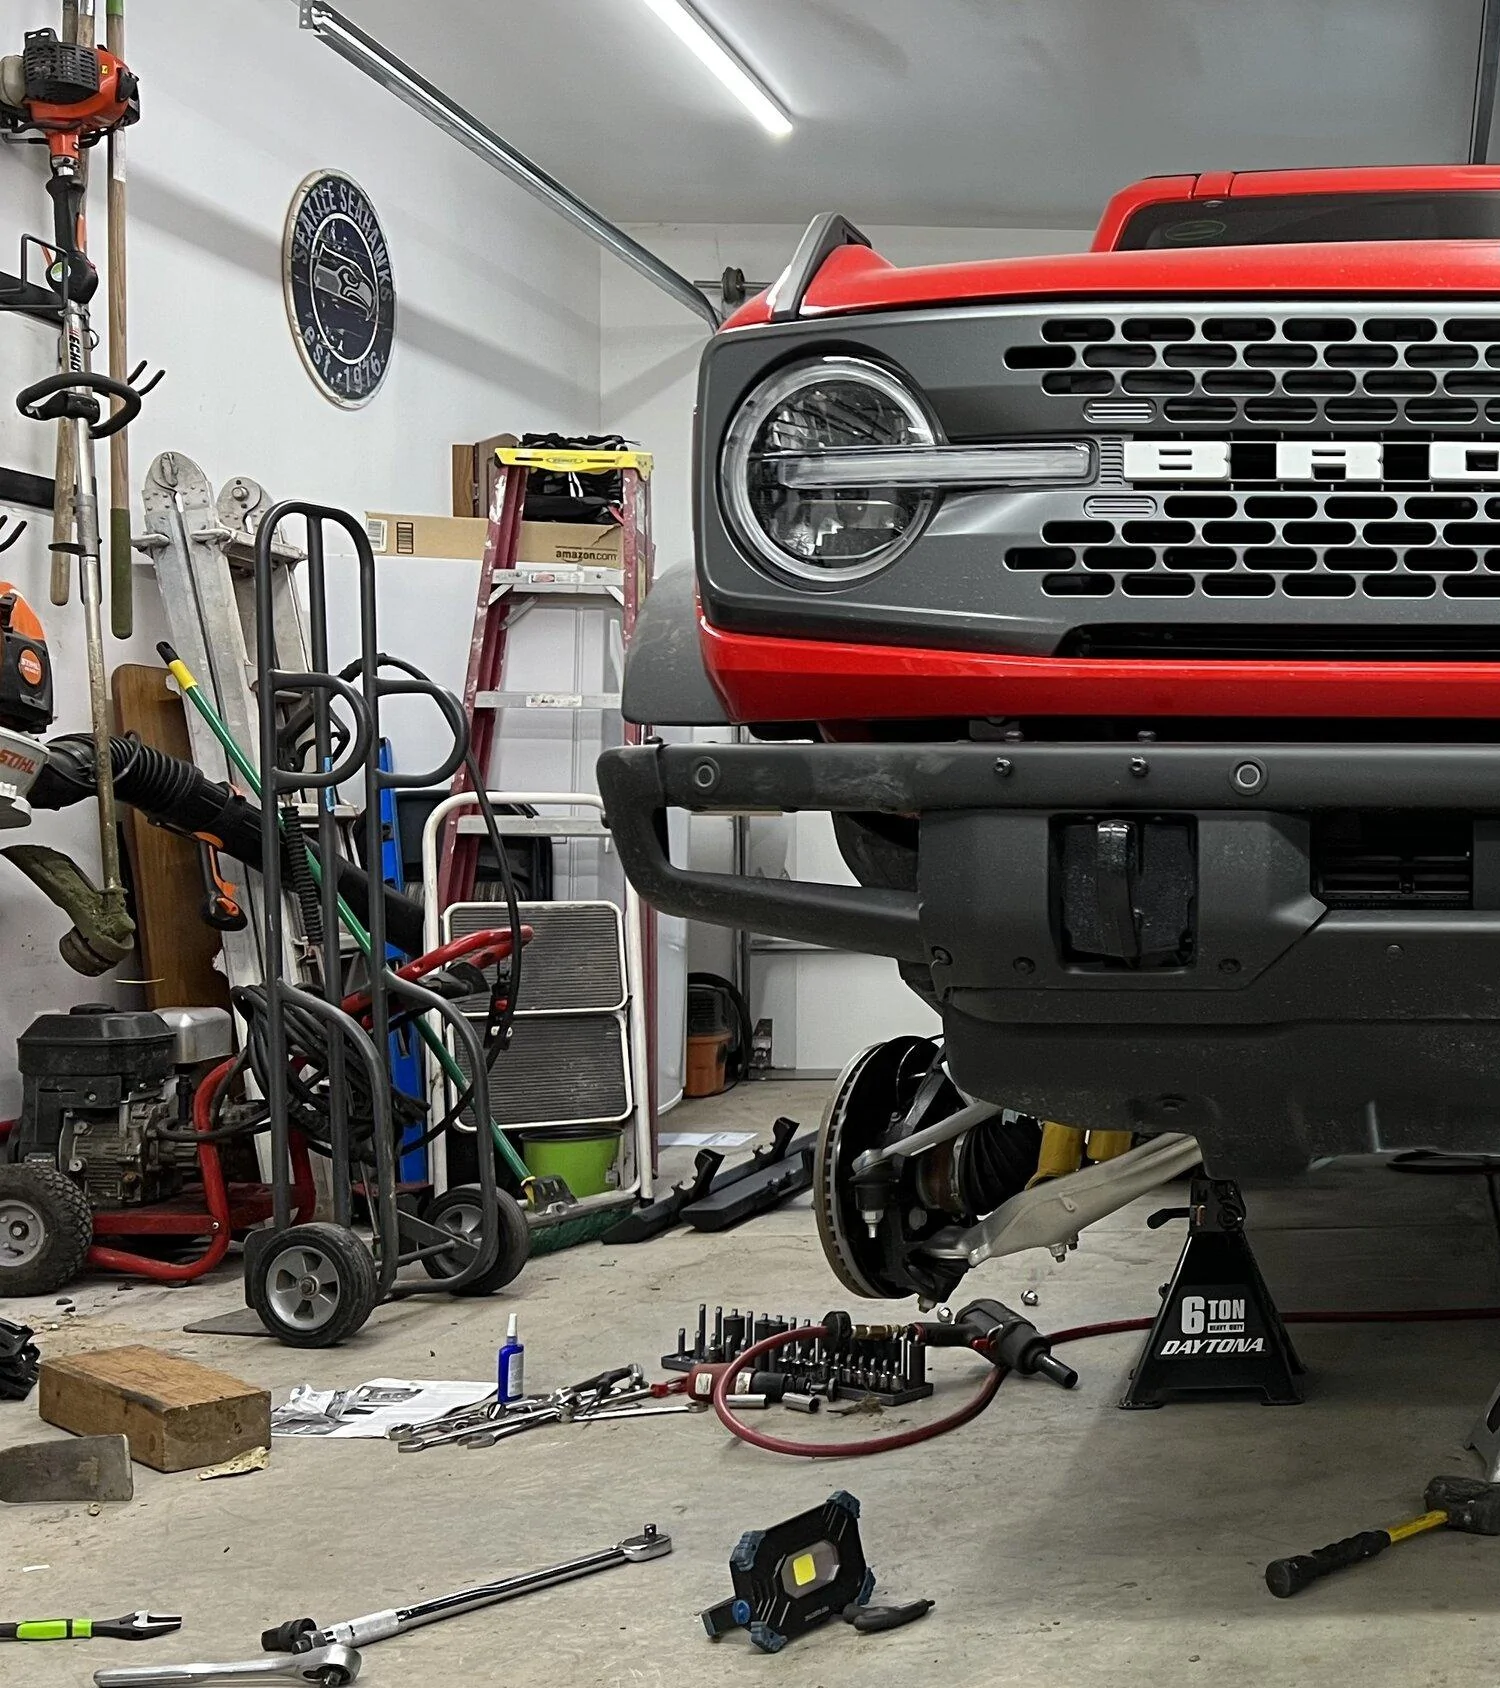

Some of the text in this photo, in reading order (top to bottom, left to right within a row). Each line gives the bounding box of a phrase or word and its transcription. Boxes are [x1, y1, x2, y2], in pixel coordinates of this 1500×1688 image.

[292, 181, 393, 302] SEATTLE SEAHAWKS
[344, 351, 381, 393] 1976
[555, 549, 618, 564] amazon.com
[1181, 1296, 1245, 1335] 6 TON
[1160, 1338, 1265, 1355] DAYTONA
